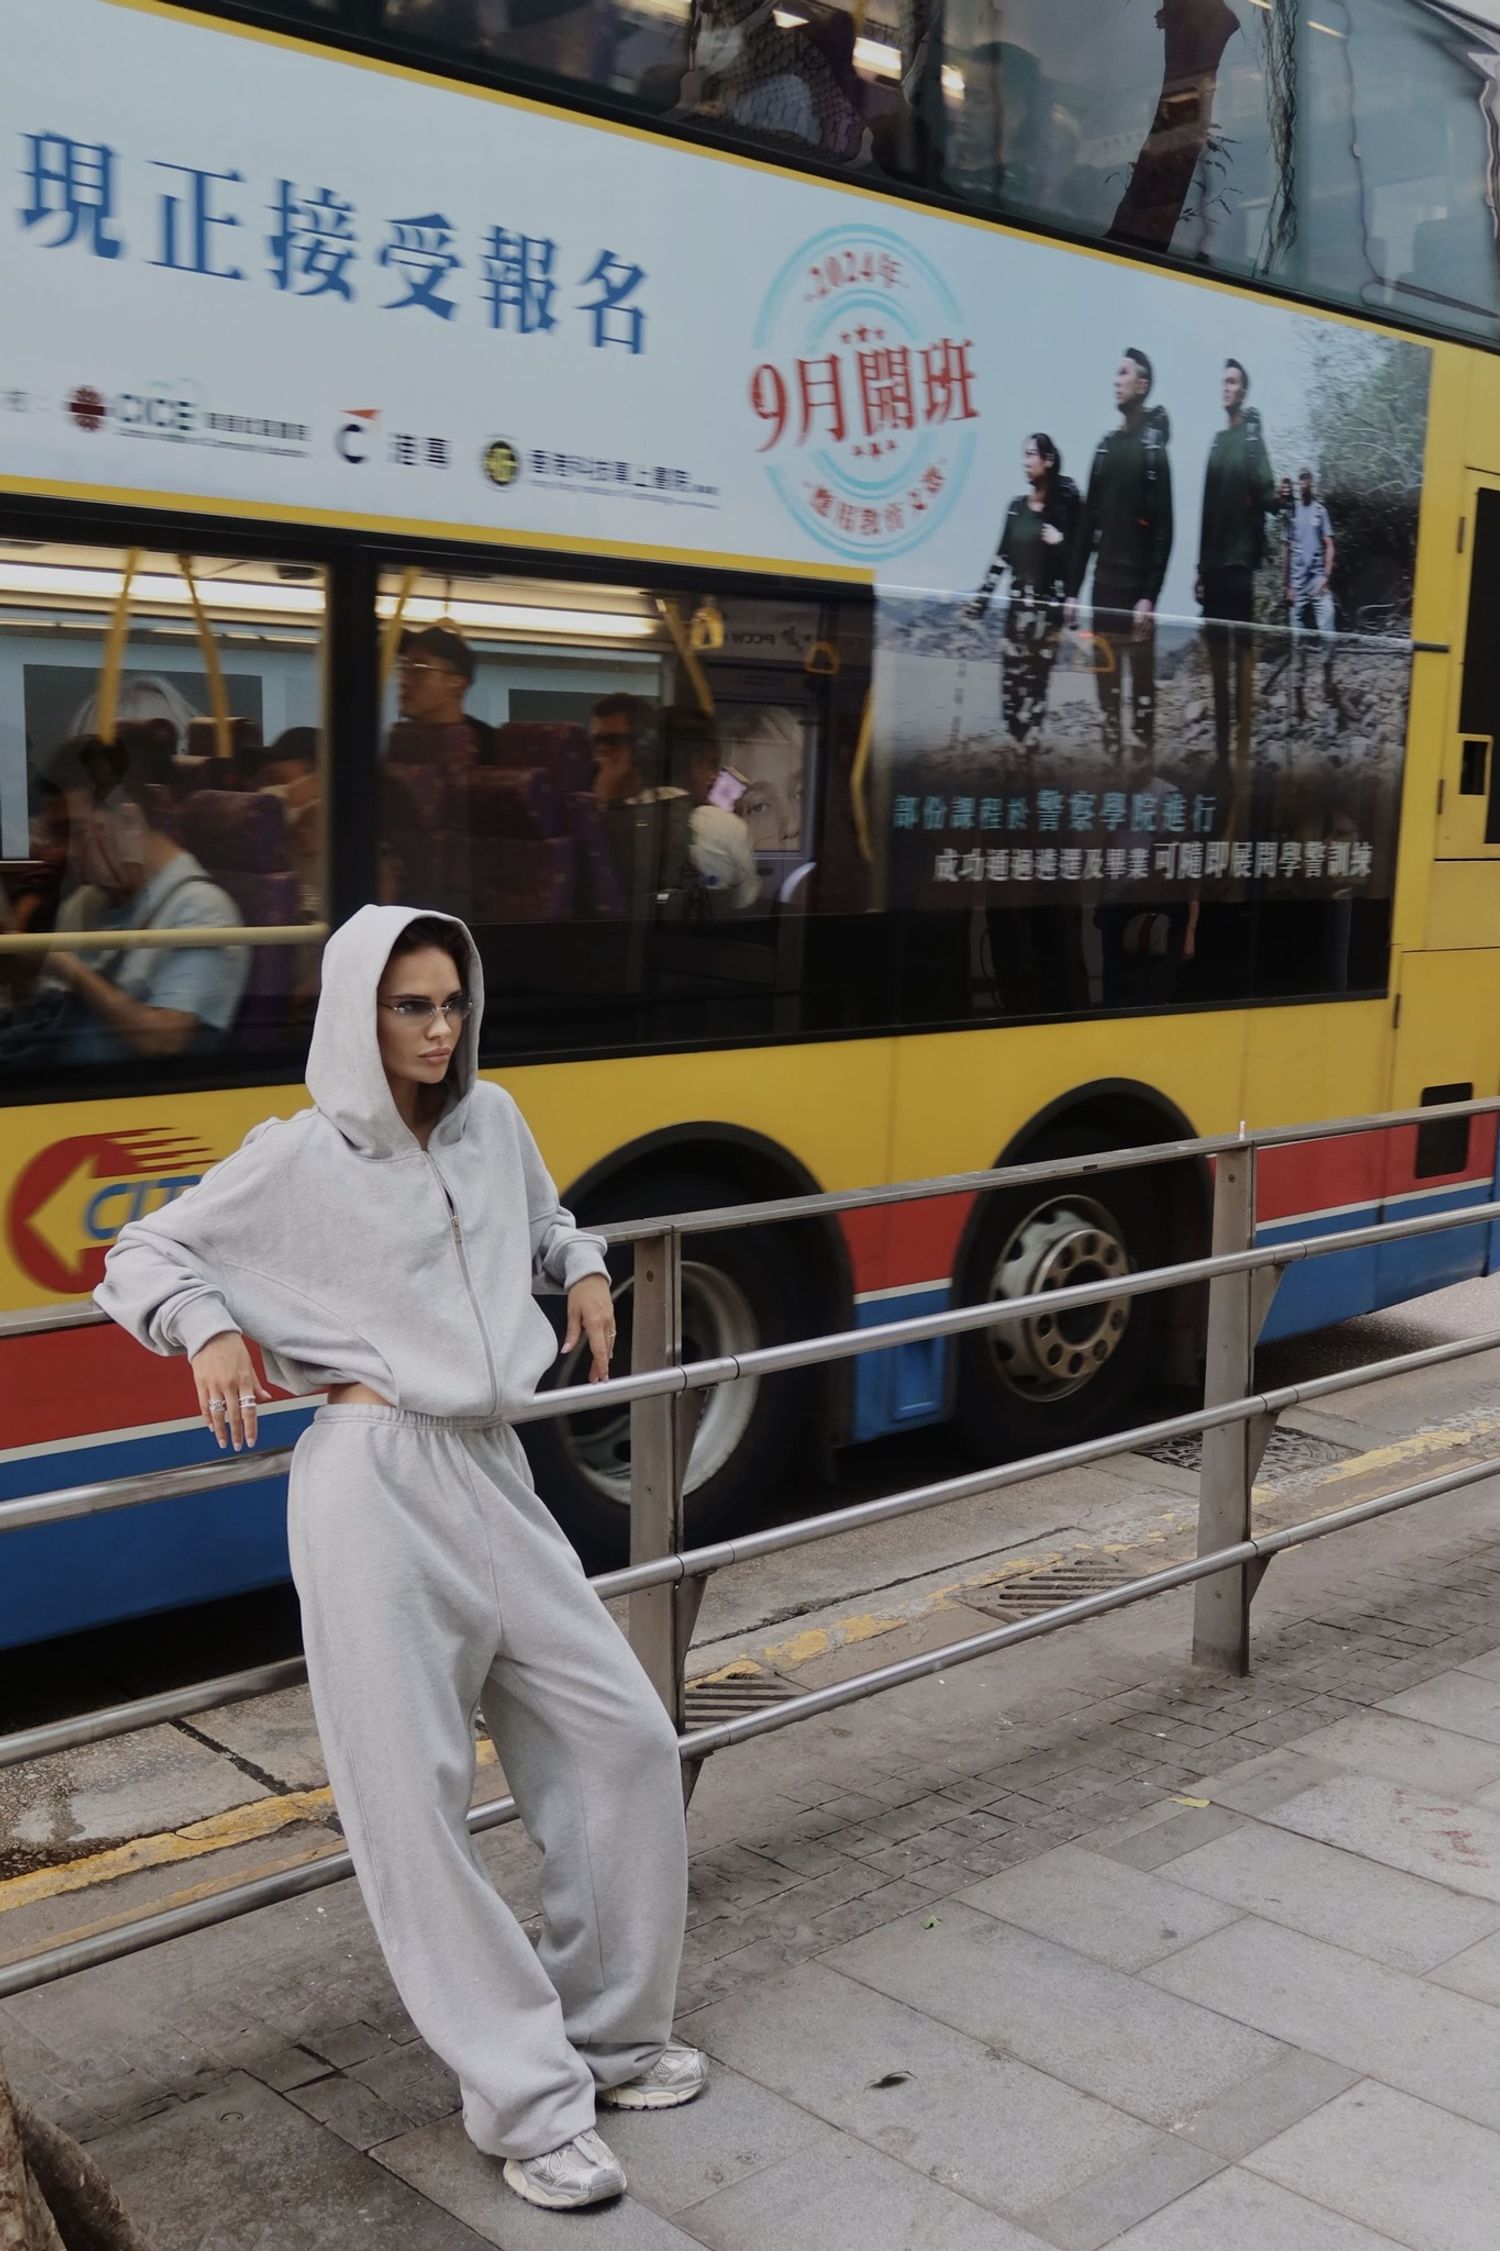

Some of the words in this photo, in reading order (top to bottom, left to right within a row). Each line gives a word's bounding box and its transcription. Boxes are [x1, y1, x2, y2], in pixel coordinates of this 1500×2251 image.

[15, 128, 652, 356] 現正接受報名
[751, 337, 980, 452] 9月開班
[84, 1174, 204, 1241] CIT
